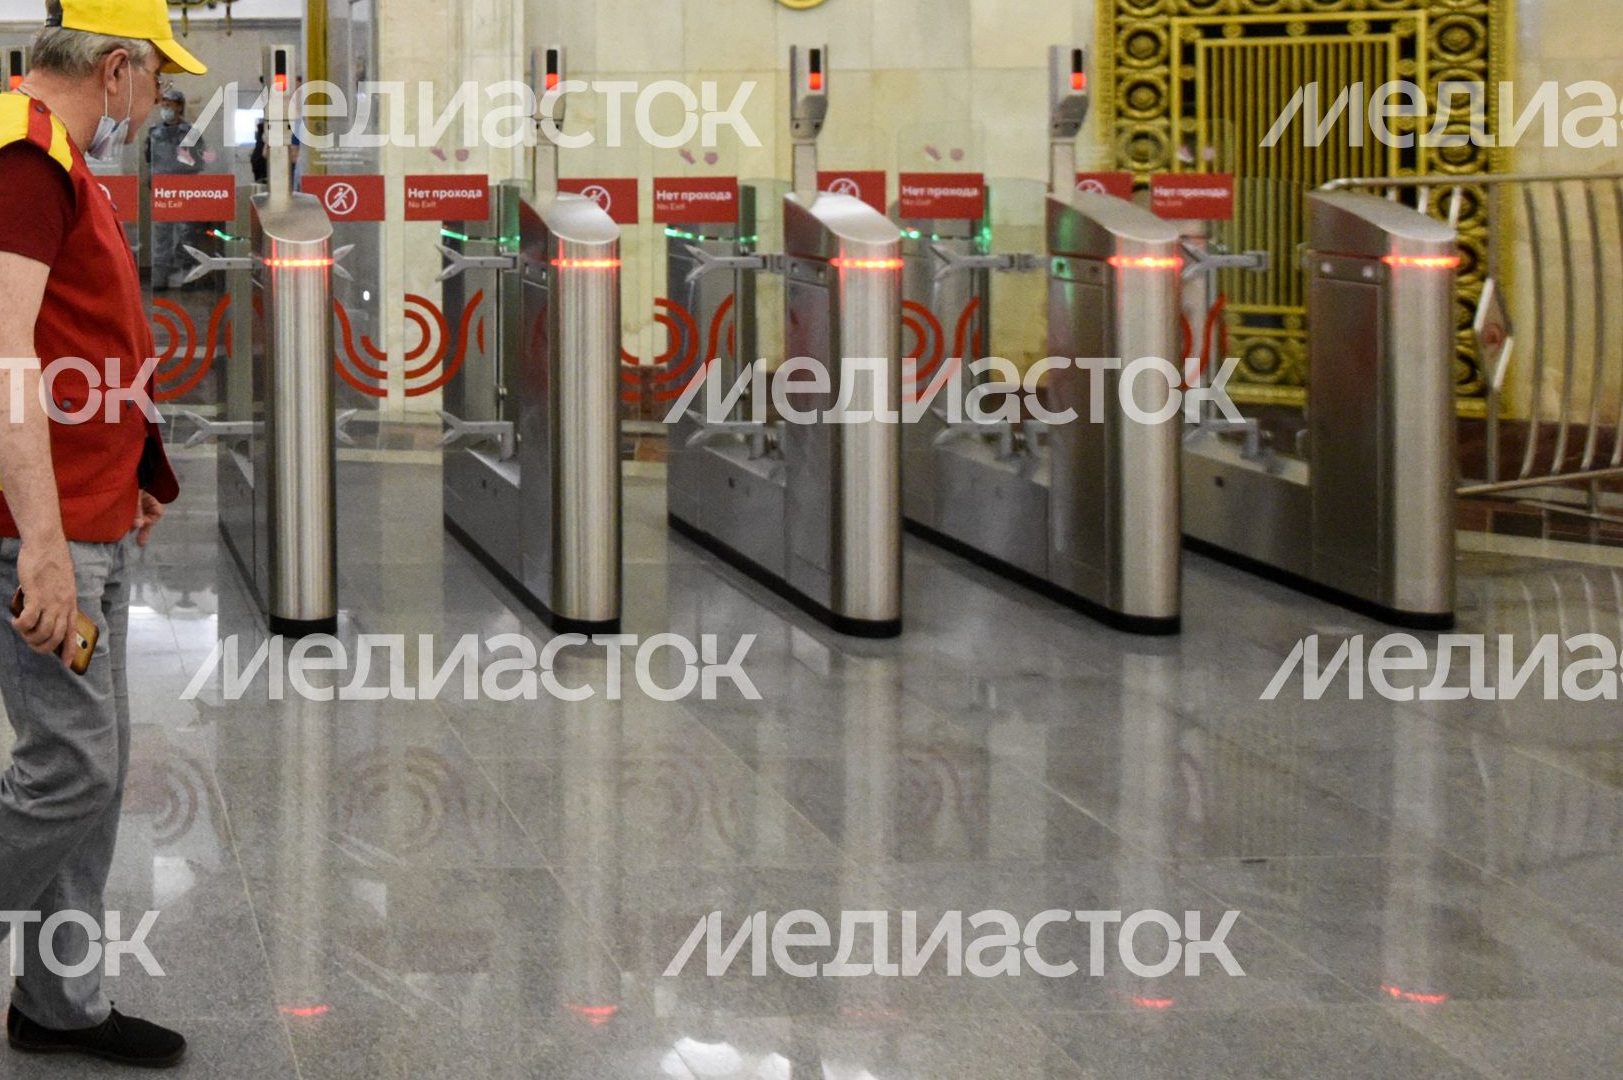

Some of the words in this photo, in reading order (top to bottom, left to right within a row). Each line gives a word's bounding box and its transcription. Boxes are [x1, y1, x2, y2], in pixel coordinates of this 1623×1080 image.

[154, 187, 177, 199] Нет
[178, 189, 229, 201] прохода
[408, 187, 431, 199] Нет
[432, 189, 483, 201] прохода
[656, 189, 679, 201] Нет
[681, 191, 732, 203] прохода
[902, 185, 925, 197] Нет
